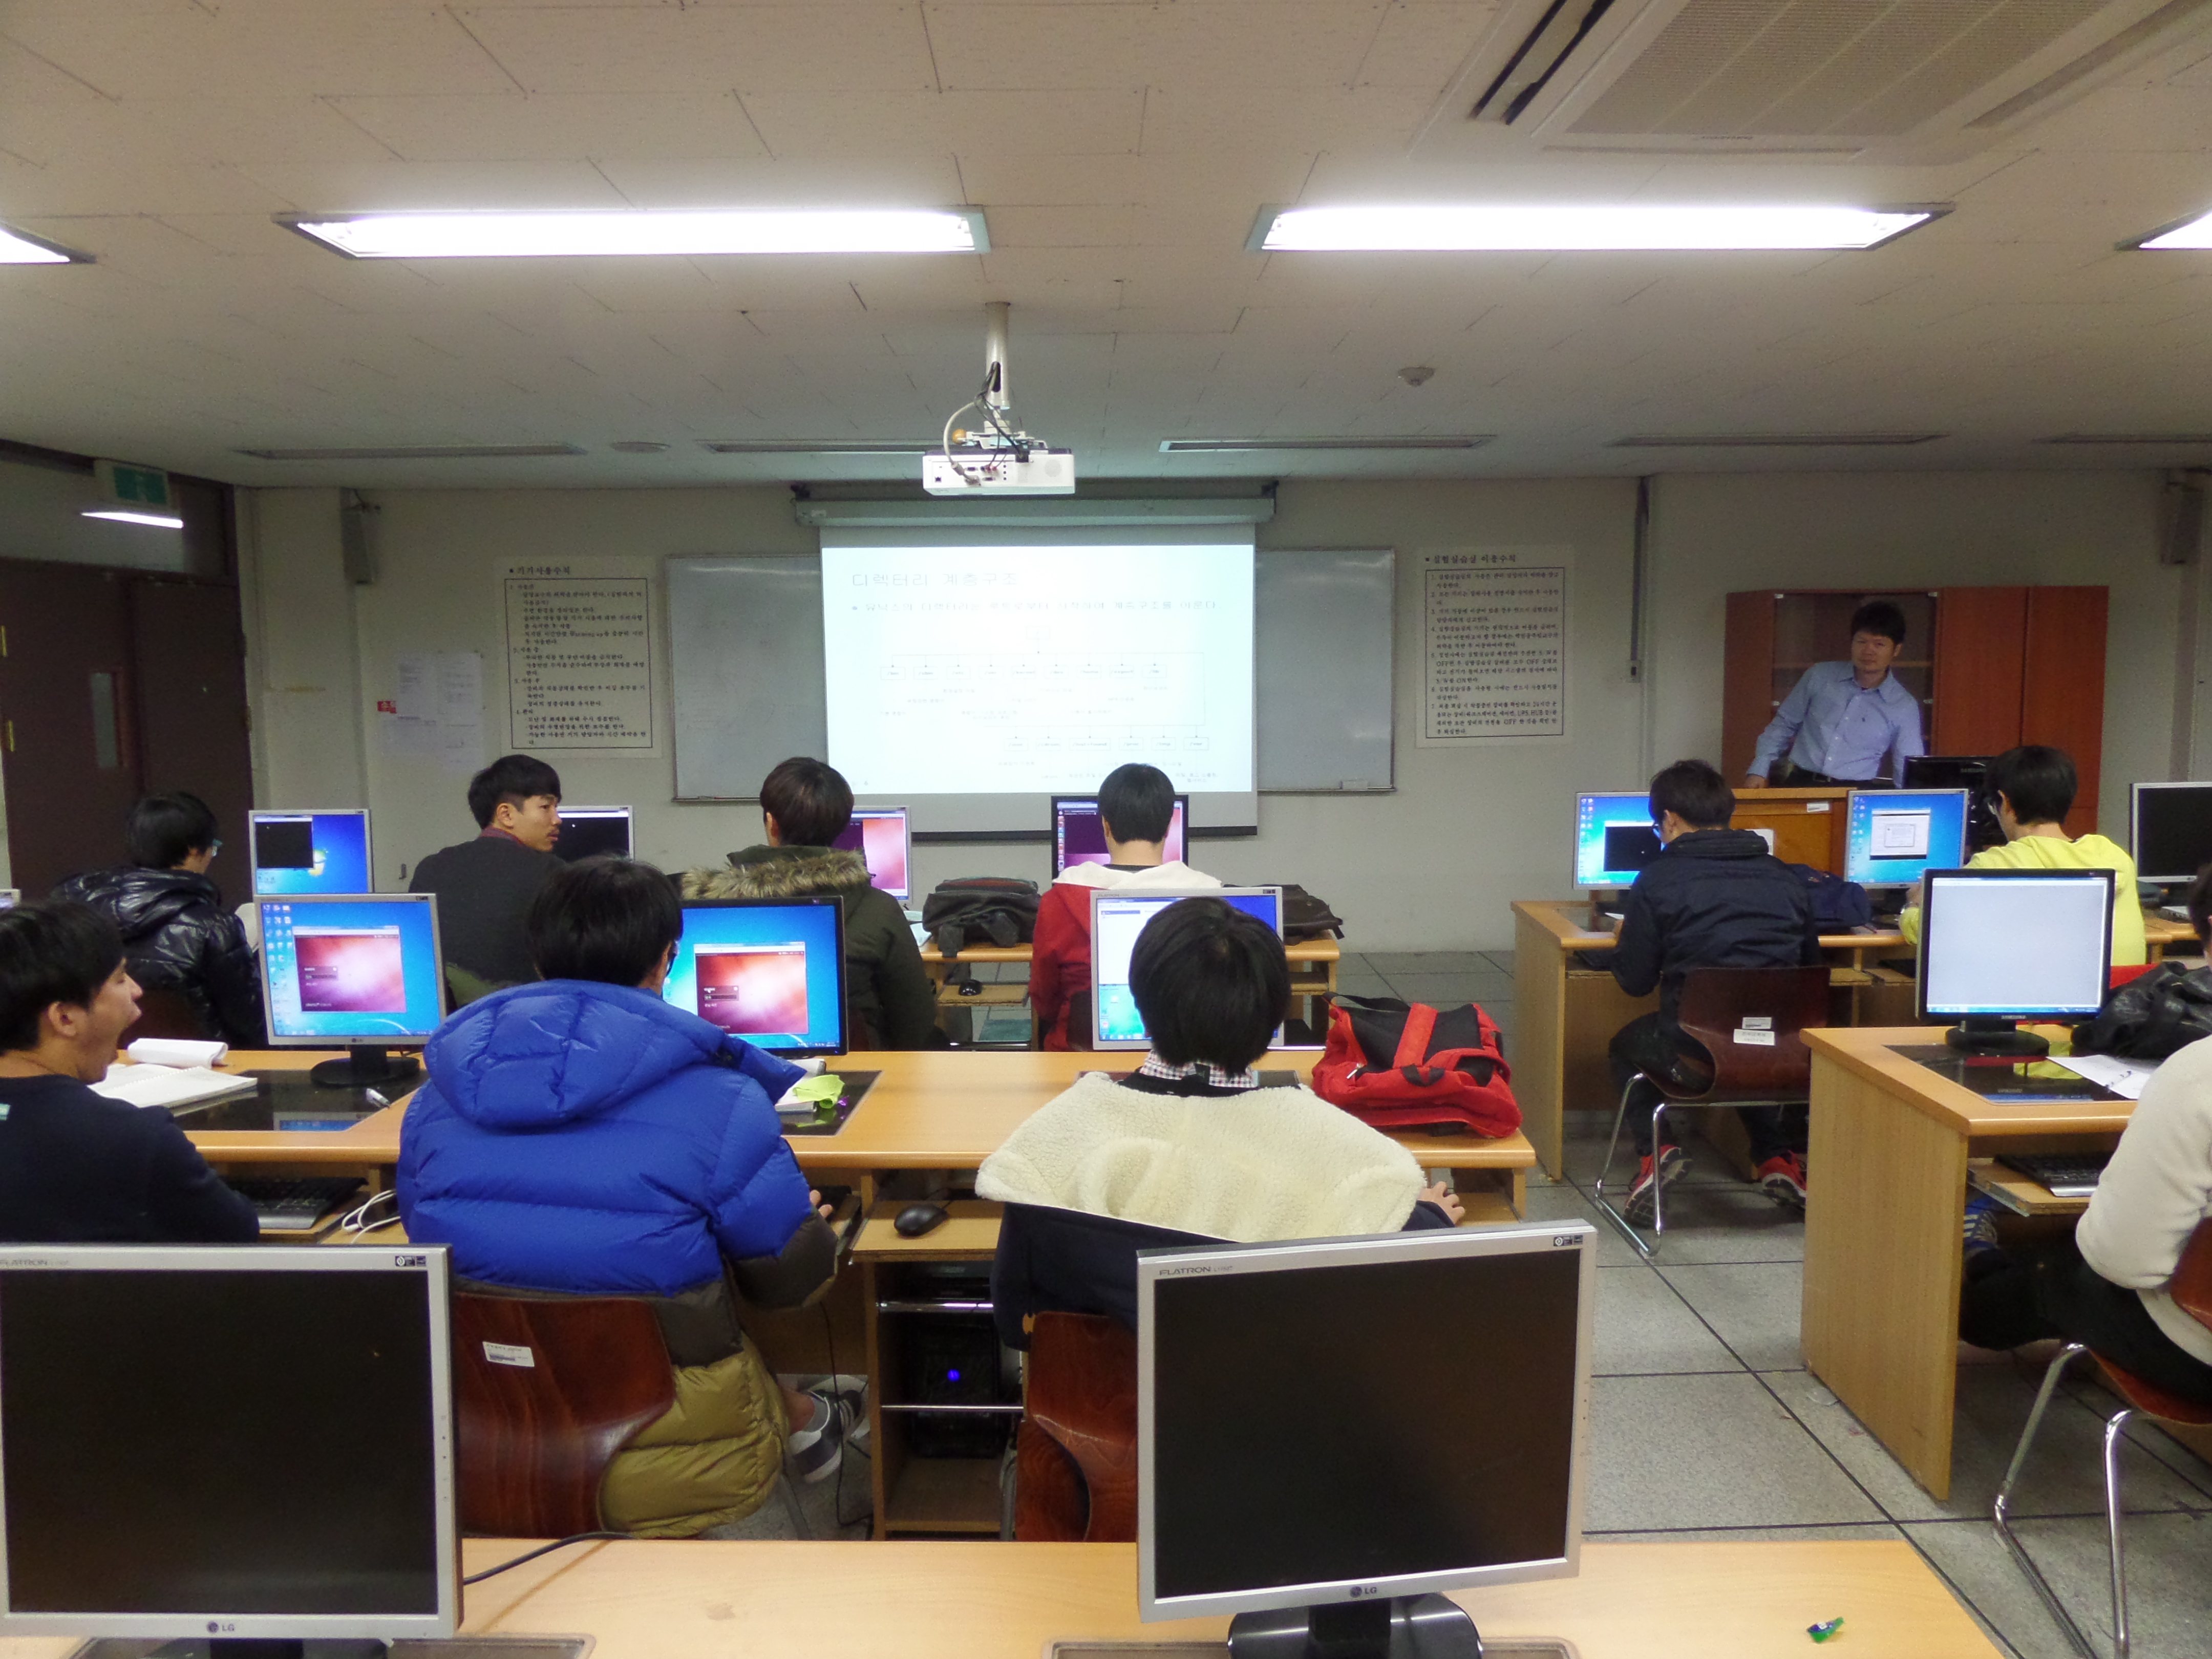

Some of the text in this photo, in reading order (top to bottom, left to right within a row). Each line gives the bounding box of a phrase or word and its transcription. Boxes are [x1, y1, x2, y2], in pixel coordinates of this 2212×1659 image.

[853, 573, 1017, 586] 디렉터리 계층구조
[1160, 1266, 1210, 1275] FLATRON
